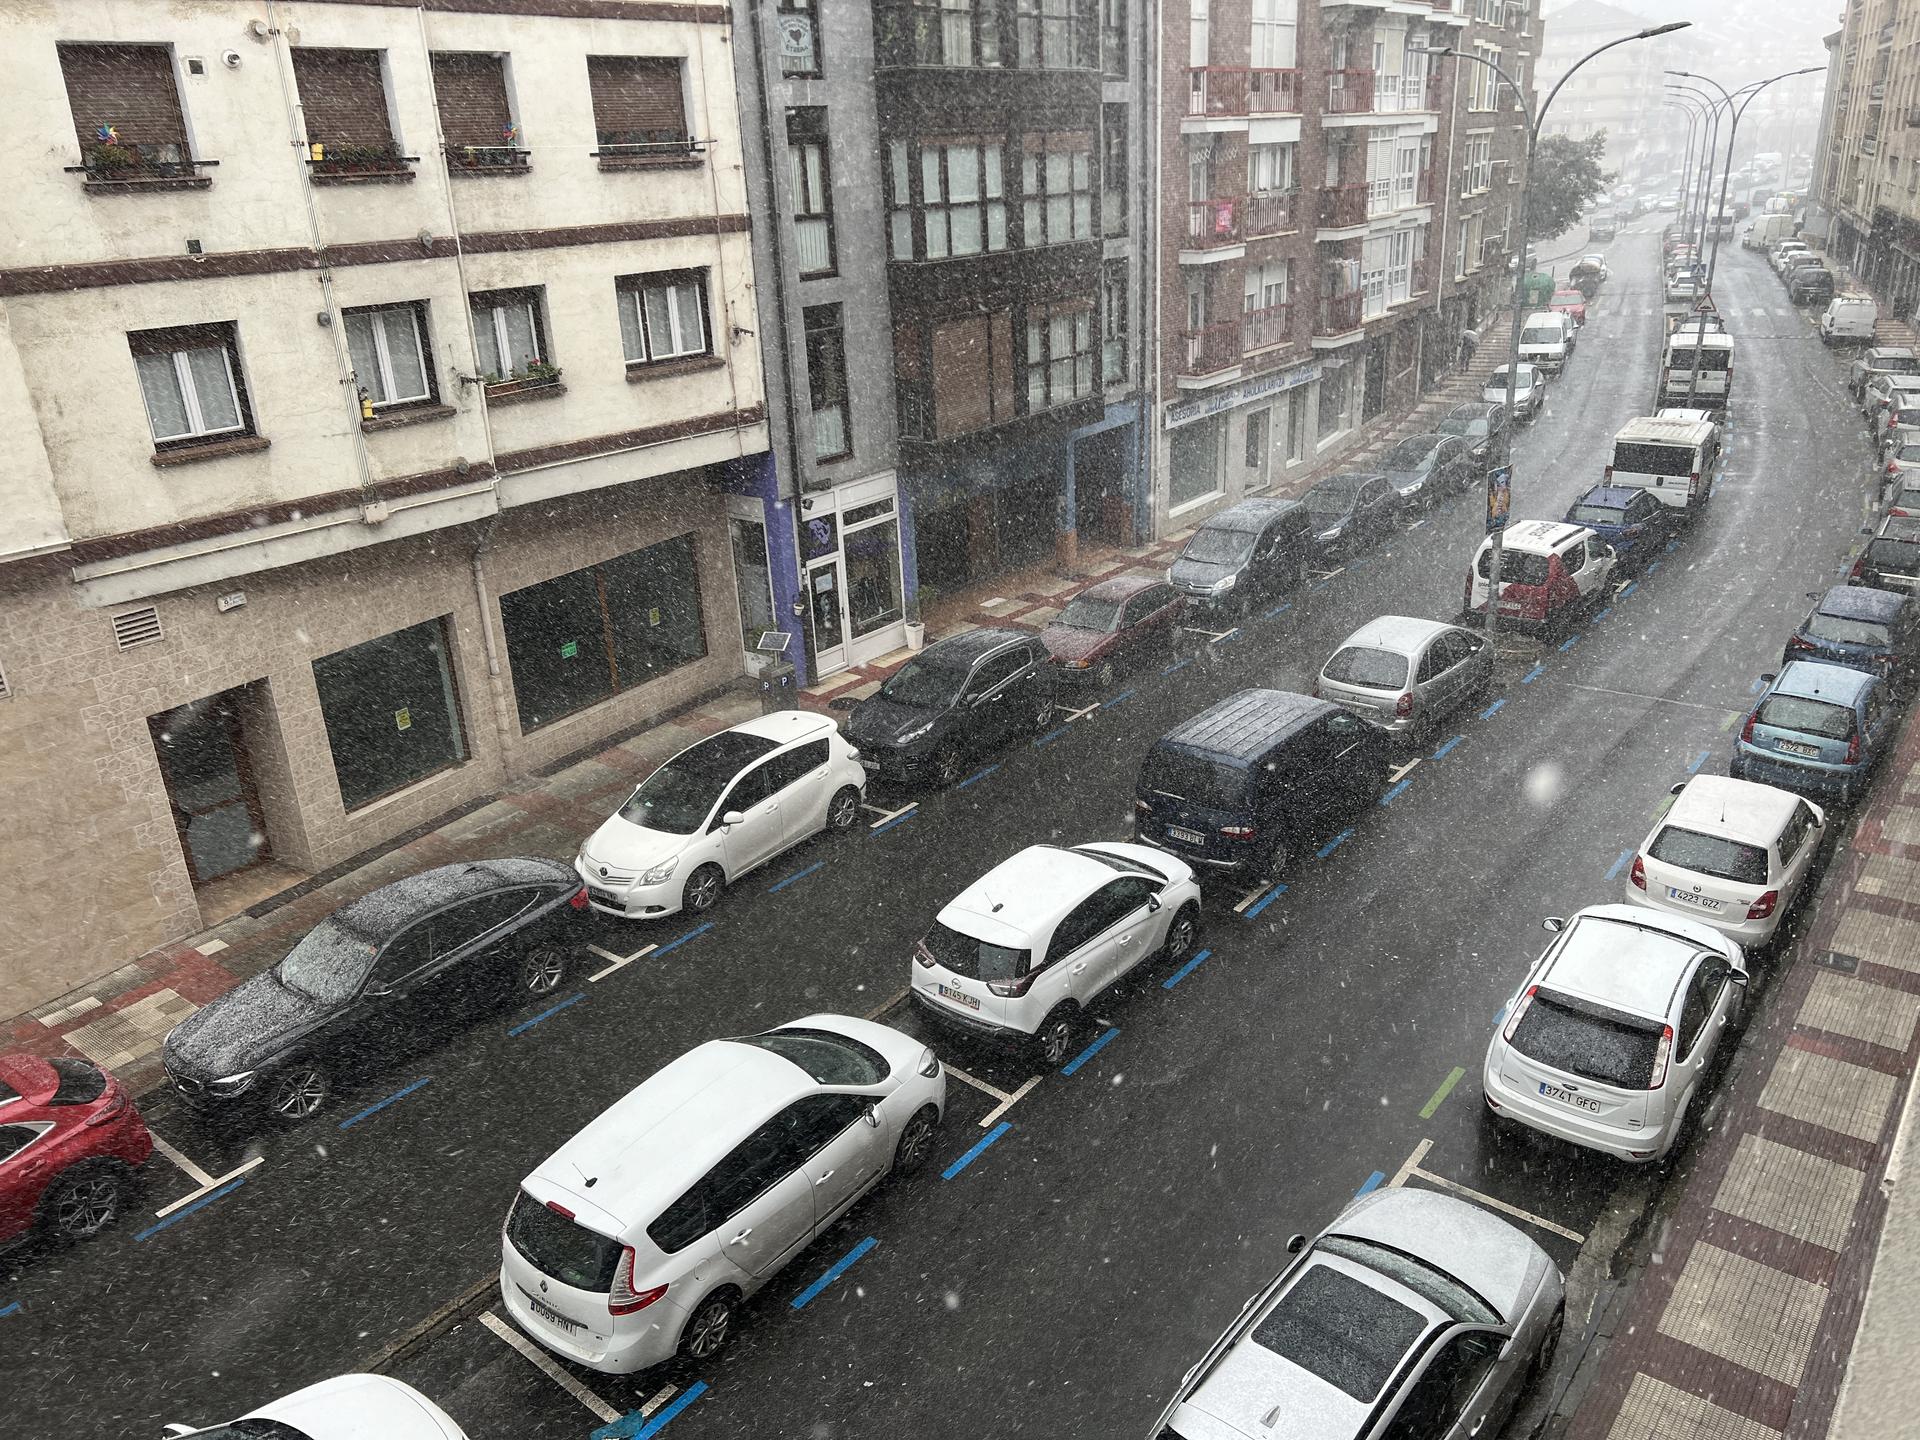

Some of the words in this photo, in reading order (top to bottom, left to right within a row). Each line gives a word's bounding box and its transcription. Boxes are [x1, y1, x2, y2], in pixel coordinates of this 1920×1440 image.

[1171, 404, 1201, 424] ASESORIA
[782, 676, 788, 686] P
[1677, 891, 1699, 904] 4223
[1702, 899, 1720, 909] GZZ
[1546, 1086, 1572, 1102] 3741
[1576, 1096, 1597, 1111] GFC
